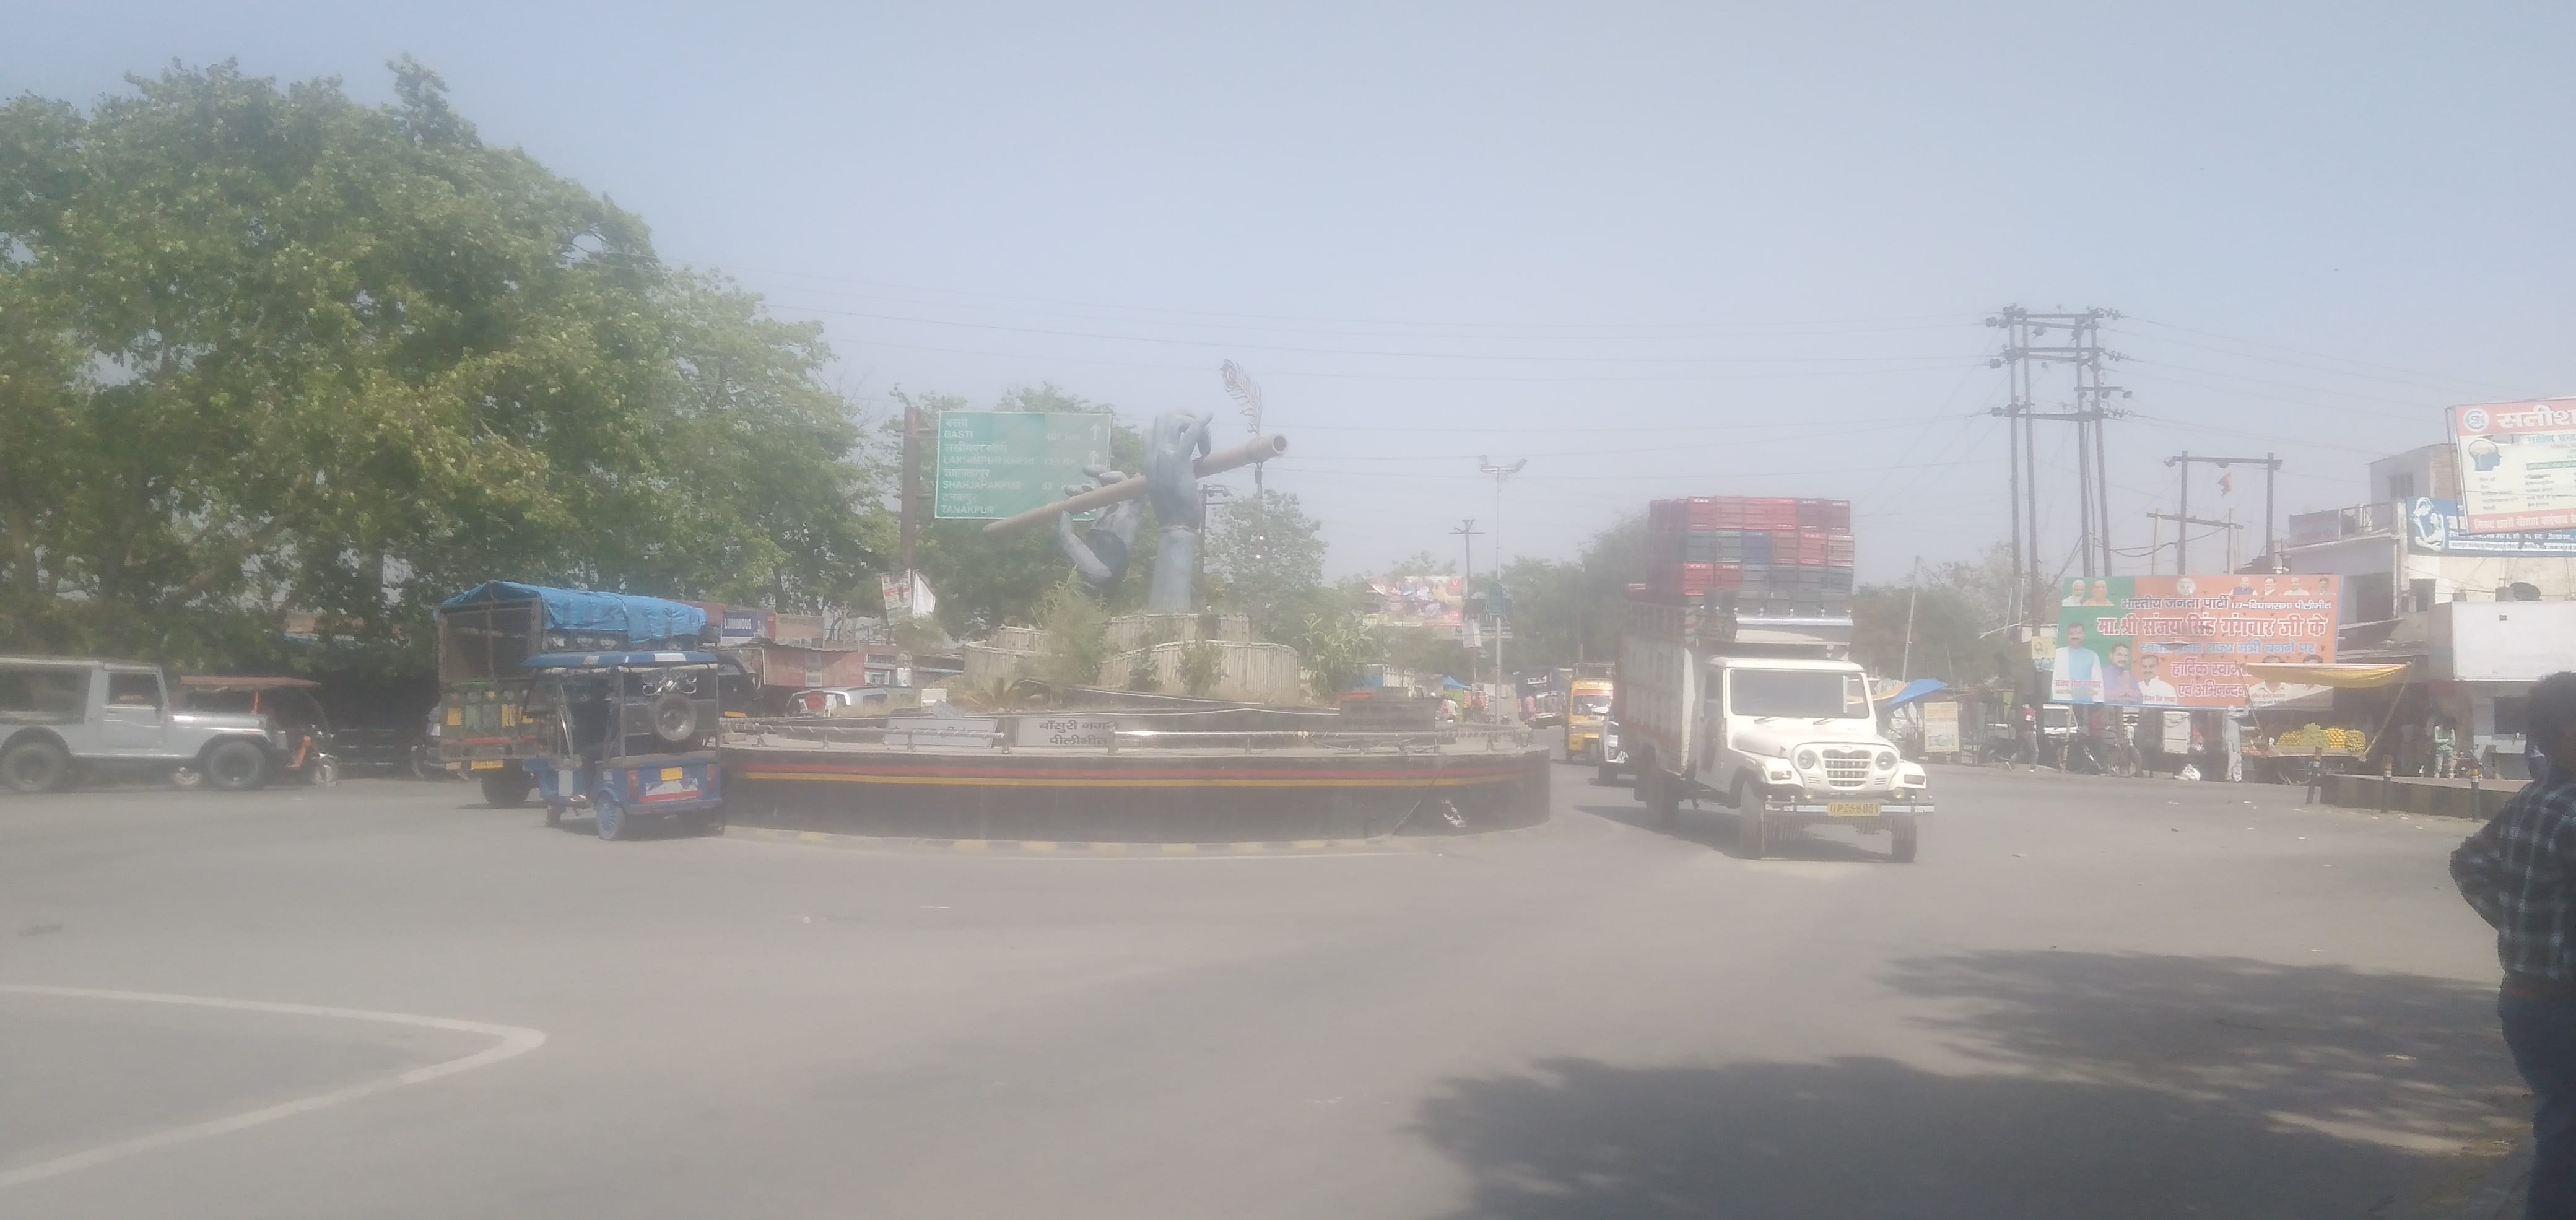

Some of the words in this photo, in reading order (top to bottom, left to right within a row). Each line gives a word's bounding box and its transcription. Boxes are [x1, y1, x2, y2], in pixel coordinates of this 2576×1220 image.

[944, 430, 973, 438] BASTI
[943, 455, 1001, 464] LAKHIMPUR
[1003, 456, 1035, 466] KHERI
[942, 481, 1021, 490] SHAHJAHANPUR
[942, 505, 994, 514] TANAKPUR
[2121, 595, 2162, 609] भारतीय
[2165, 598, 2200, 609] जनता
[2203, 593, 2229, 609] पार्टी
[2294, 599, 2332, 609] पीलीभीत
[2142, 612, 2186, 635] संजय
[2186, 612, 2217, 636] सिंह
[2219, 612, 2276, 637] गंगवार
[2278, 613, 2305, 637] जी
[2307, 613, 2328, 636] के
[2237, 638, 2262, 653] मंत्री
[2265, 640, 2295, 653] बनने
[2298, 642, 2318, 653] पर
[2171, 656, 2208, 677] हार्दिक
[2178, 679, 2194, 697] एवं
[2195, 679, 2248, 697] अभिनन्दन
[1050, 734, 1107, 745] पीलीभीत
